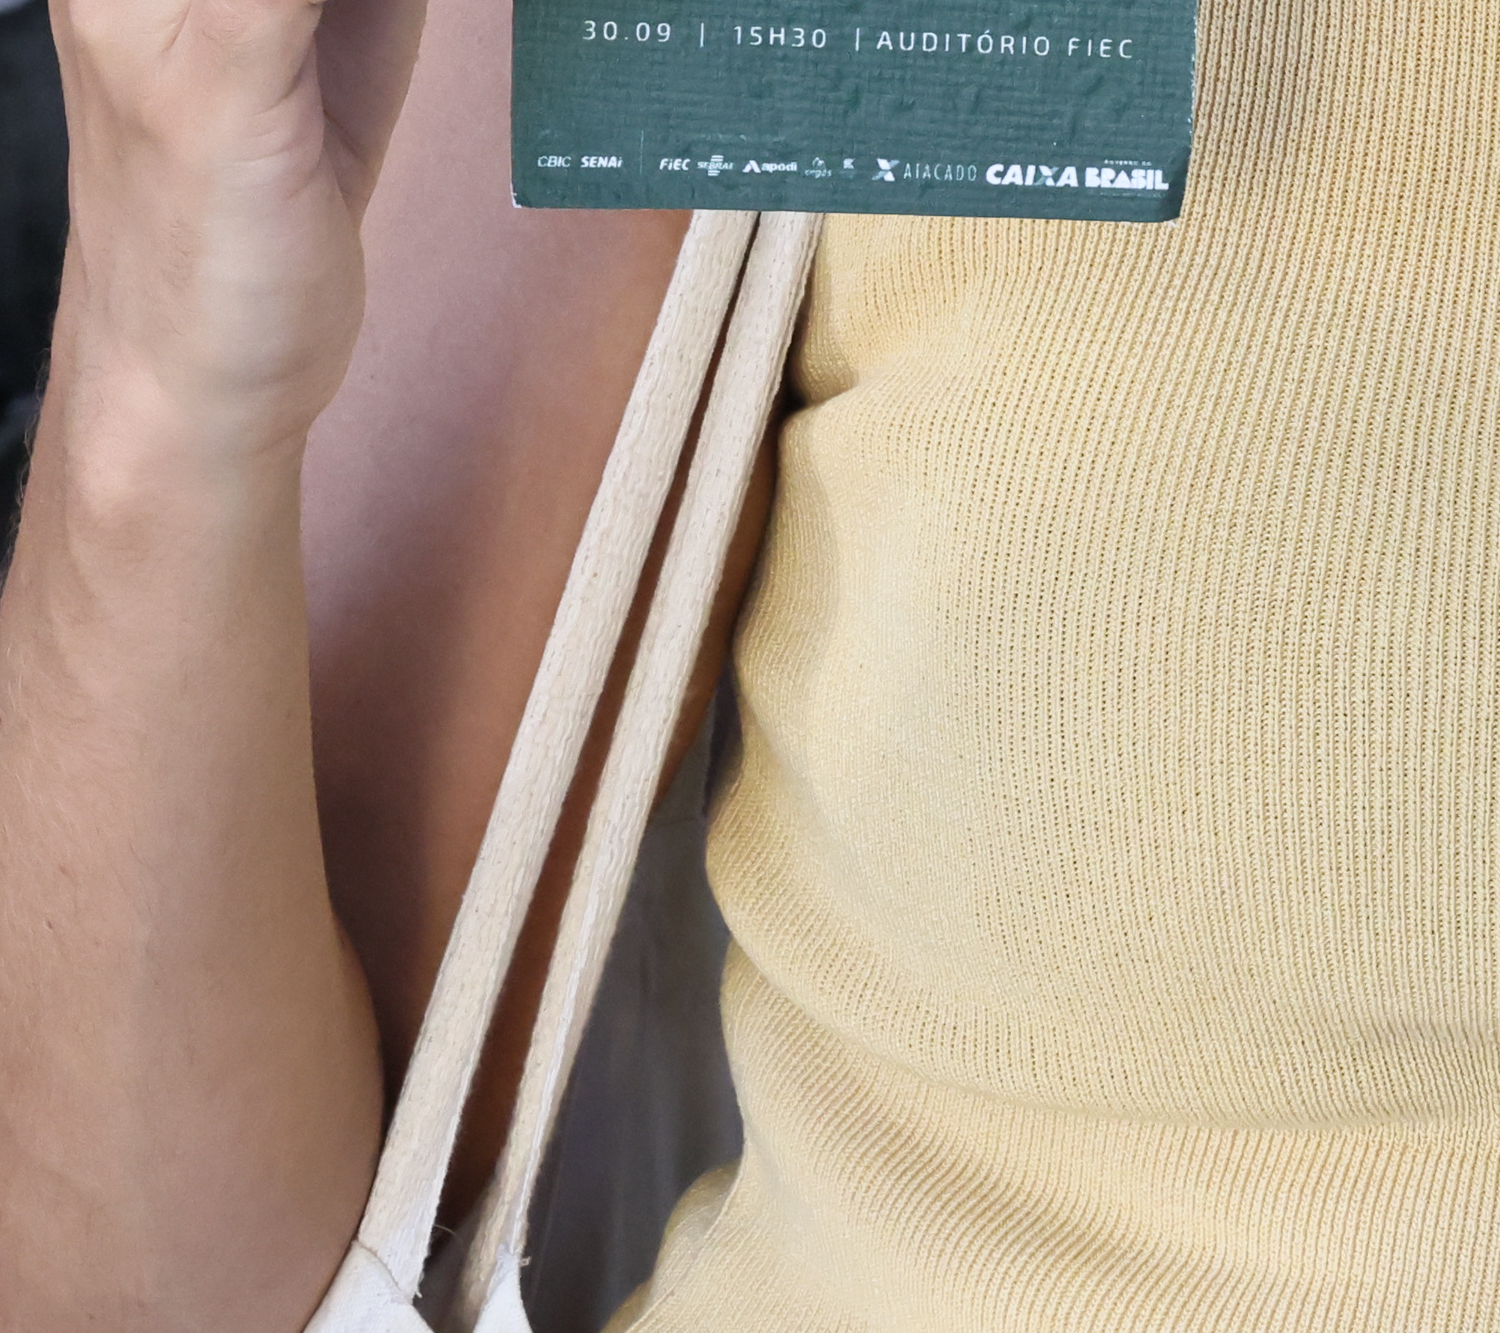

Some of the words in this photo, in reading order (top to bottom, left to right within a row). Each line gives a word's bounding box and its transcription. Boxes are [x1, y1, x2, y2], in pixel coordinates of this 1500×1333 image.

[582, 20, 671, 43] 30.09
[732, 25, 828, 49] 15H30
[875, 30, 1050, 57] AUDITÓRIO
[1067, 37, 1134, 59] FIEC
[537, 155, 572, 168] CBIC
[697, 160, 735, 171] SEBRAE
[760, 160, 798, 174] apodi
[986, 163, 1079, 188] CAIXA
[1084, 166, 1170, 191] BRASIL
